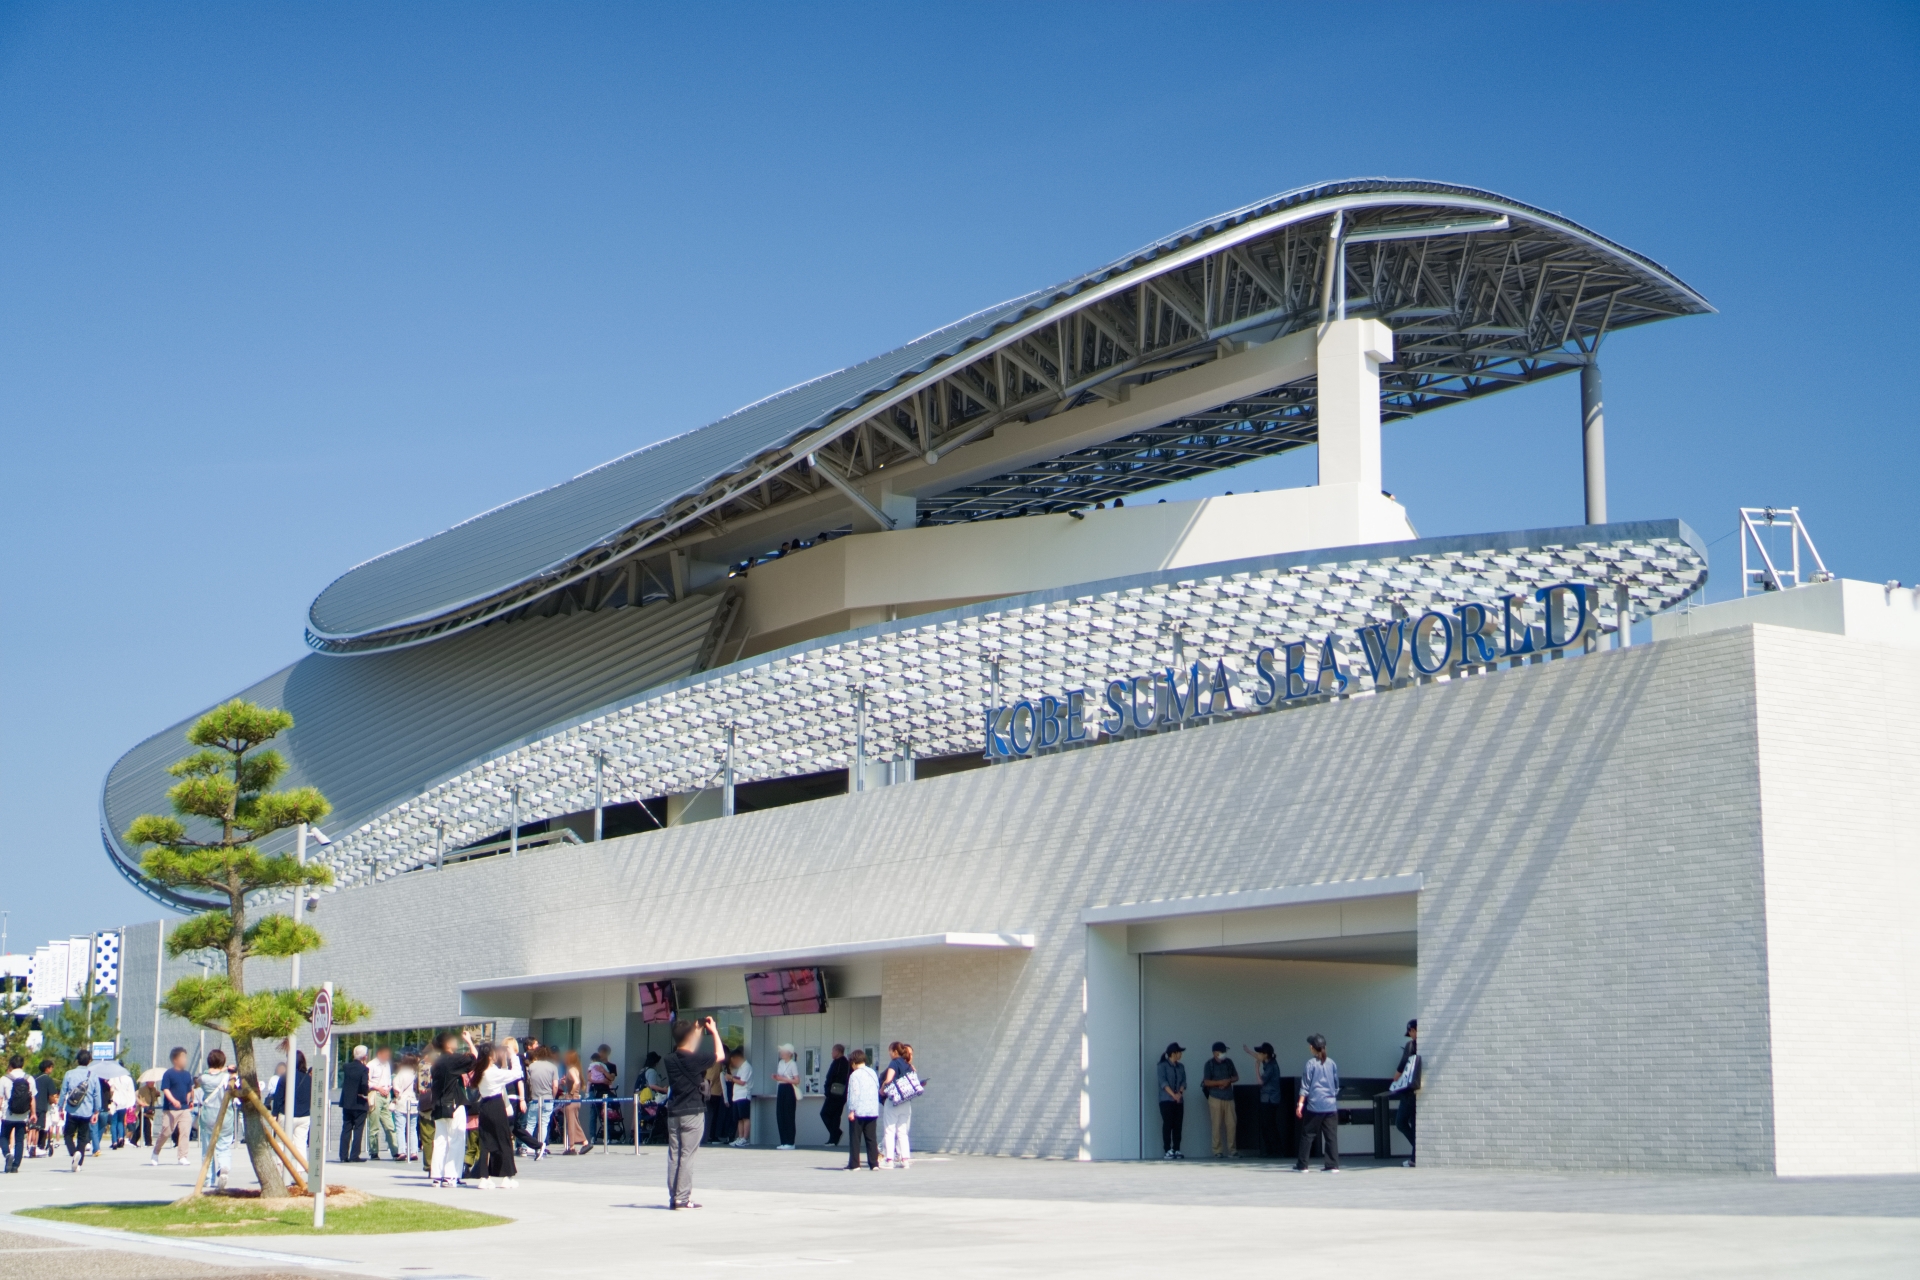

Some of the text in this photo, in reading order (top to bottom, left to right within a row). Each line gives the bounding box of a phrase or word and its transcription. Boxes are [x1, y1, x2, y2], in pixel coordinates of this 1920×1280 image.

[983, 583, 1587, 759] KOBE SUMA SEA WORLD
[314, 1068, 324, 1177] 一般車立入禁止
